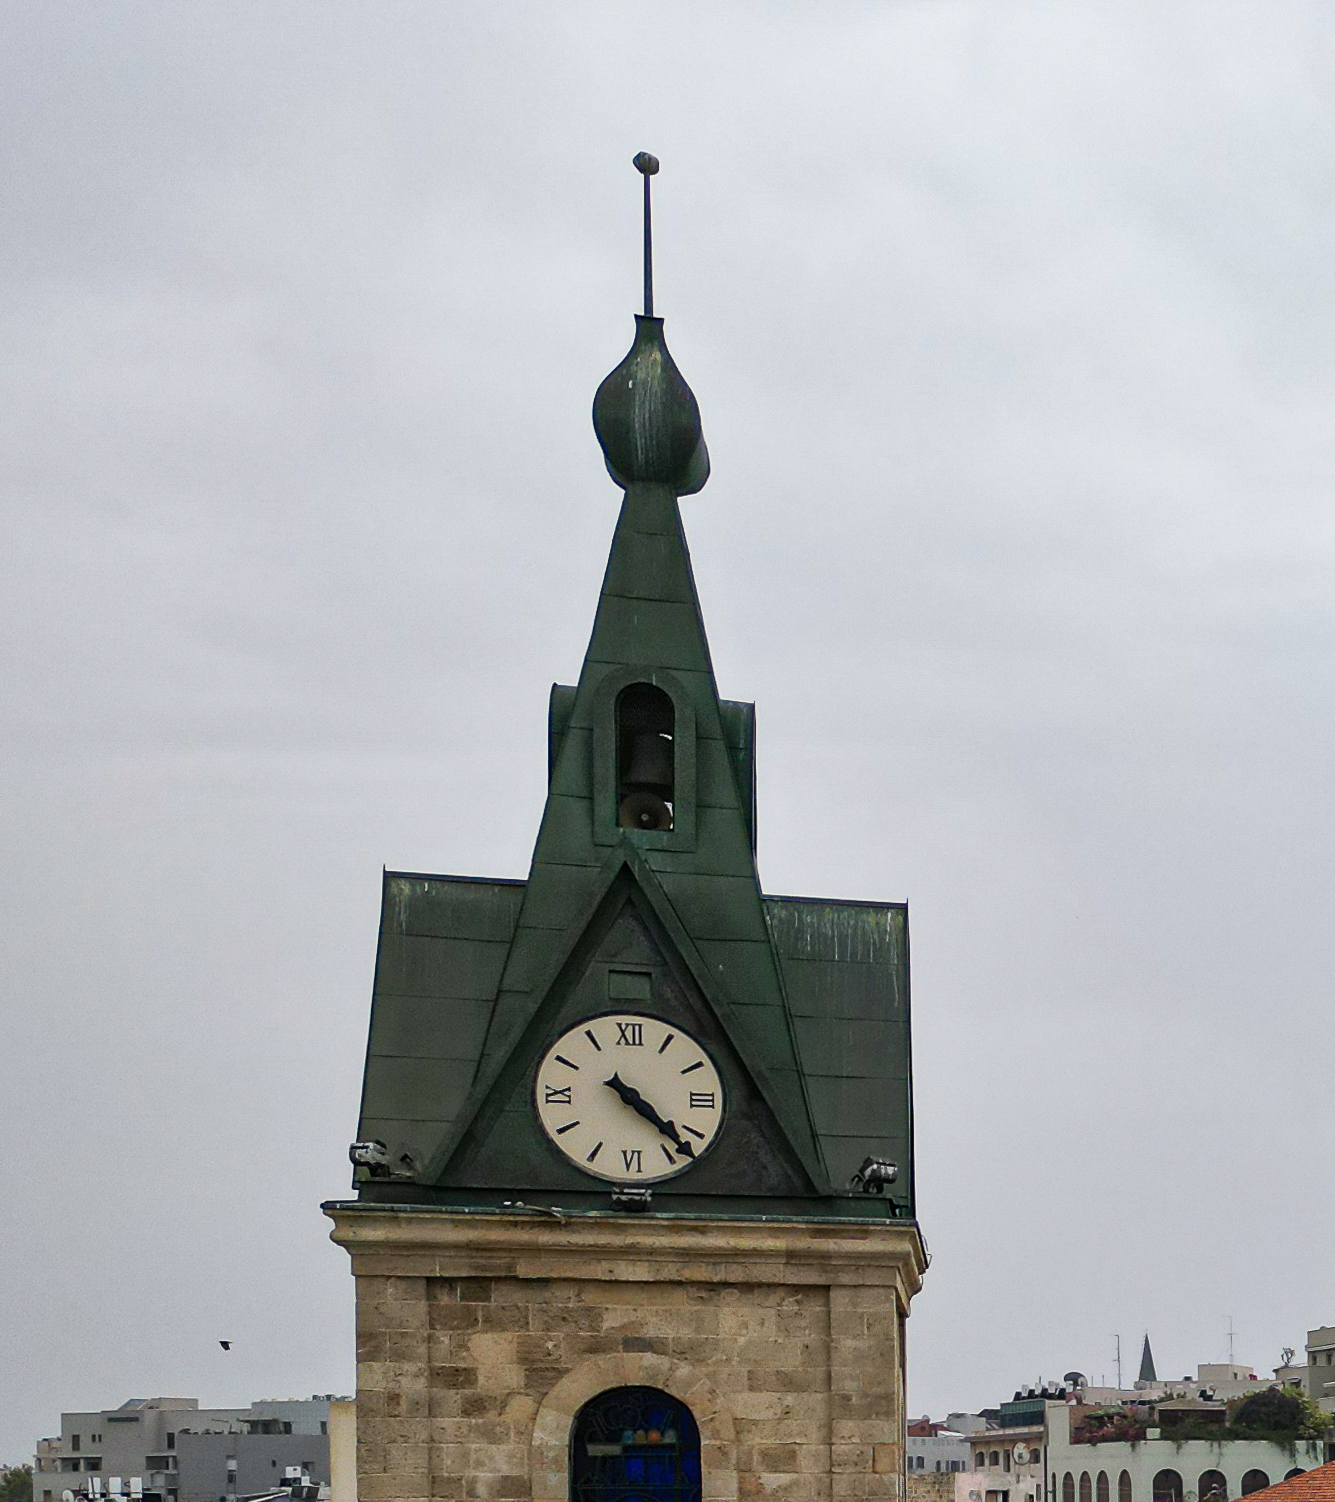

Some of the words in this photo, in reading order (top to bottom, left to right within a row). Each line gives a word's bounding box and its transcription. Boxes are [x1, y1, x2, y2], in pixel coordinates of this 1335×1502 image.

[616, 1022, 643, 1046] XII
[689, 1091, 715, 1109] III
[621, 1149, 643, 1173] VI
